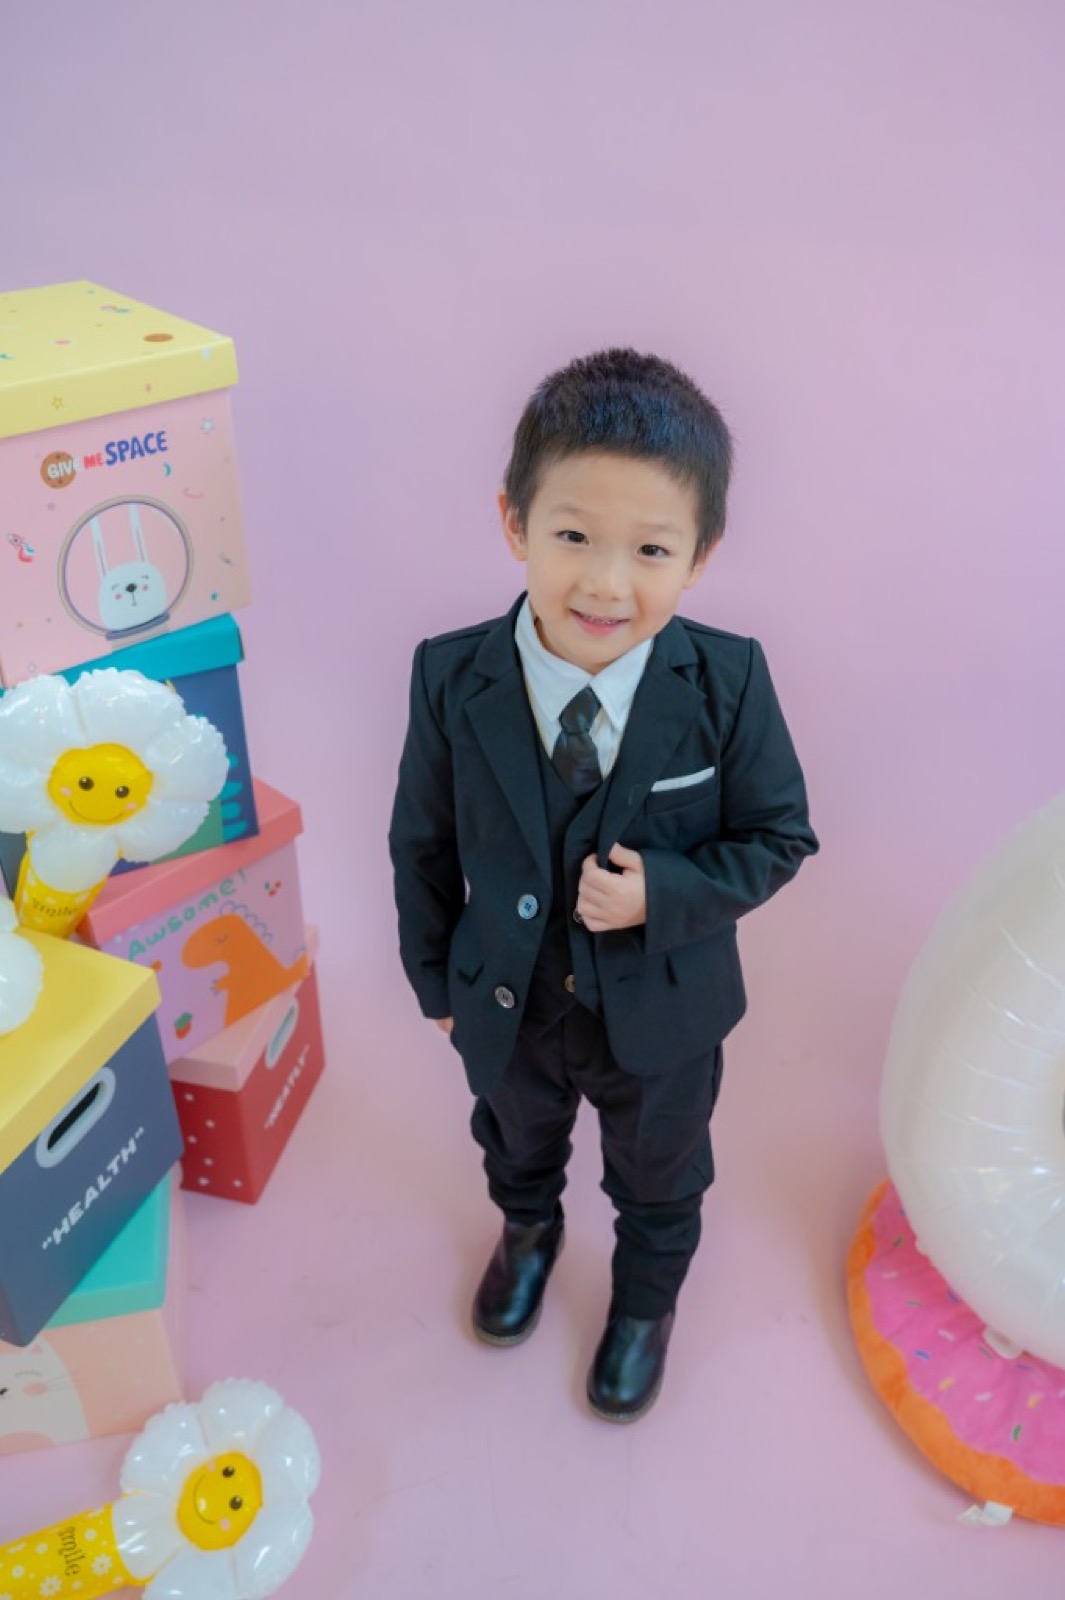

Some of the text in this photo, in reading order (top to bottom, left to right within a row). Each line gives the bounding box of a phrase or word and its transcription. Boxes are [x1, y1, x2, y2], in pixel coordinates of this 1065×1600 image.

[47, 430, 168, 480] GIVE ME SPACE
[57, 1526, 86, 1576] smile
